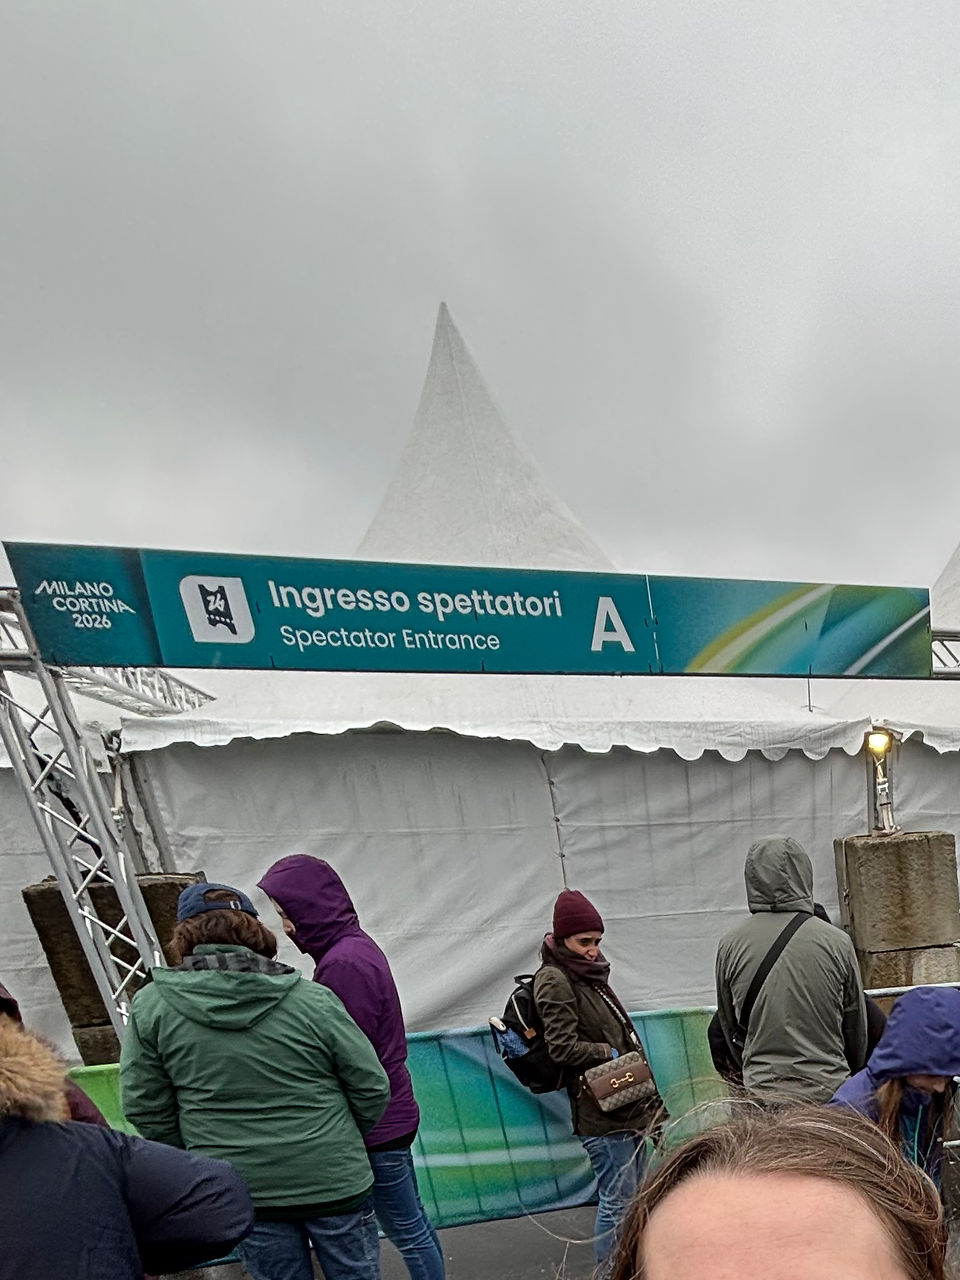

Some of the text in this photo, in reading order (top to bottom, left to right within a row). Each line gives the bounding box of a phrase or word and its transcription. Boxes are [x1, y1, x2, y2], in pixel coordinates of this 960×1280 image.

[35, 580, 114, 597] MILANO
[53, 597, 136, 614] CORTINA
[268, 580, 563, 622] Ingresso spettatori
[73, 614, 112, 629] 2026
[590, 596, 636, 652] A
[279, 625, 501, 652] Spectator Entrance
